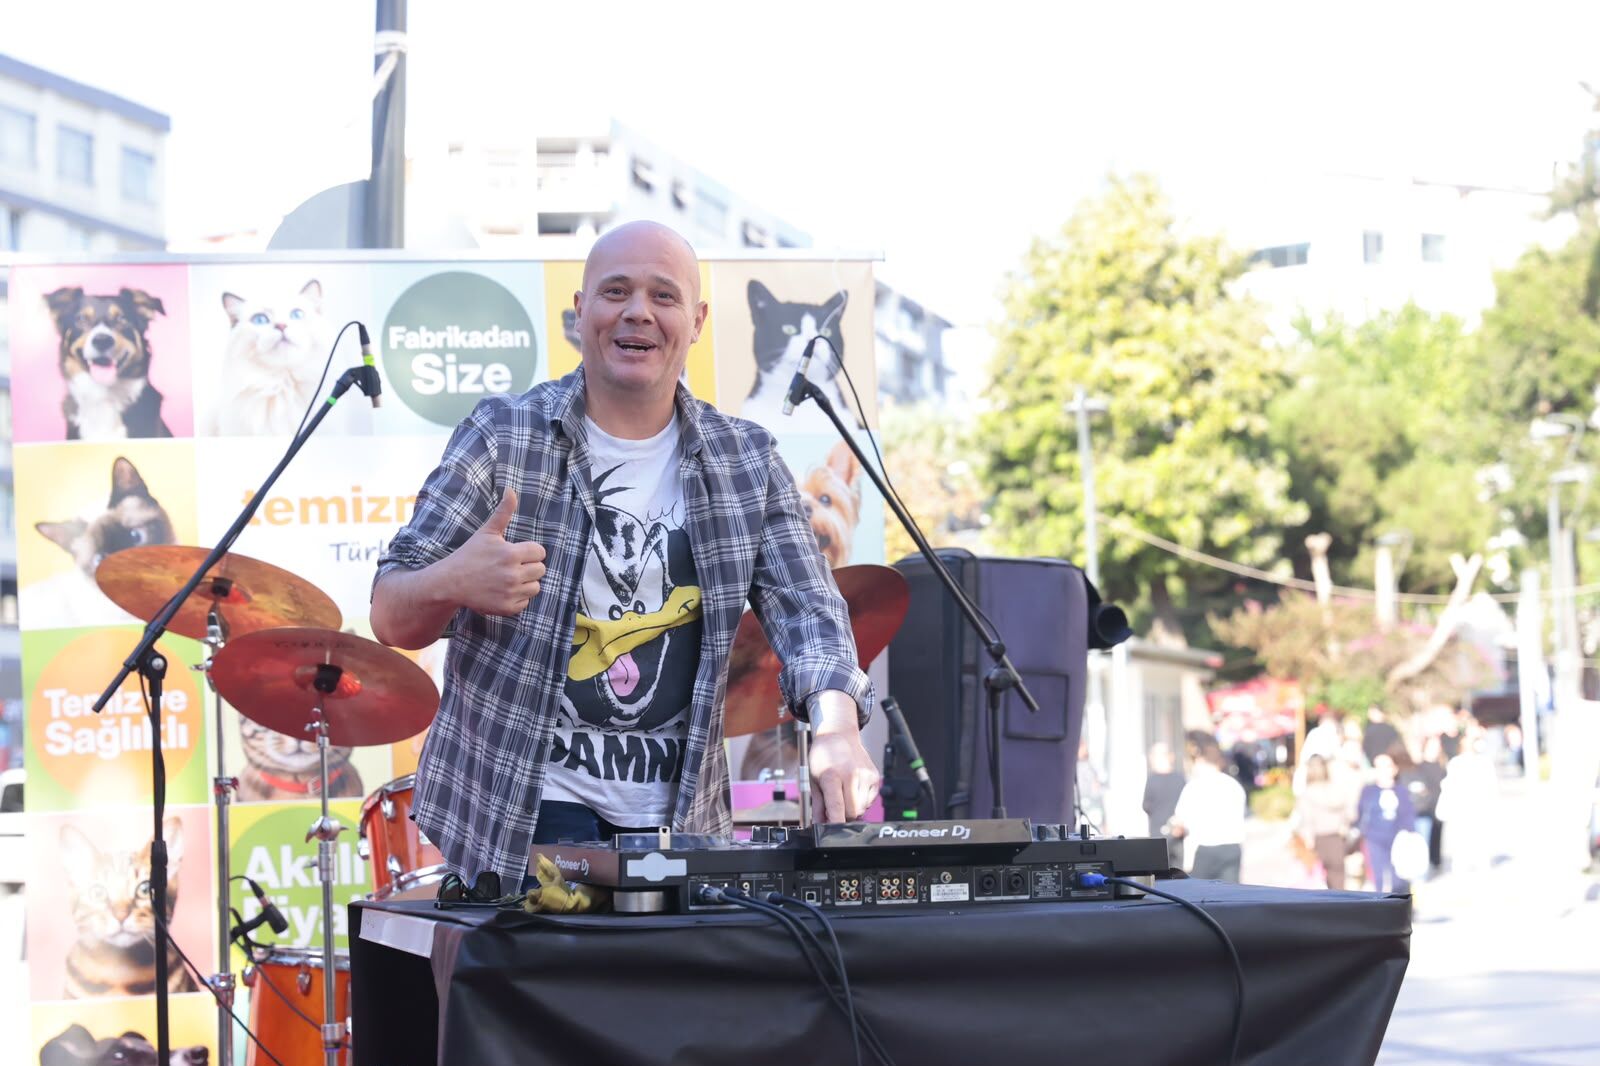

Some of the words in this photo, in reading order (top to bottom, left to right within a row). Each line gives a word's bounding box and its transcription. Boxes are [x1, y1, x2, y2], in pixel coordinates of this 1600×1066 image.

[388, 325, 531, 350] Fabrikadan
[411, 352, 513, 395] Size
[879, 825, 949, 839] Pioneer
[554, 854, 581, 871] Pioneer
